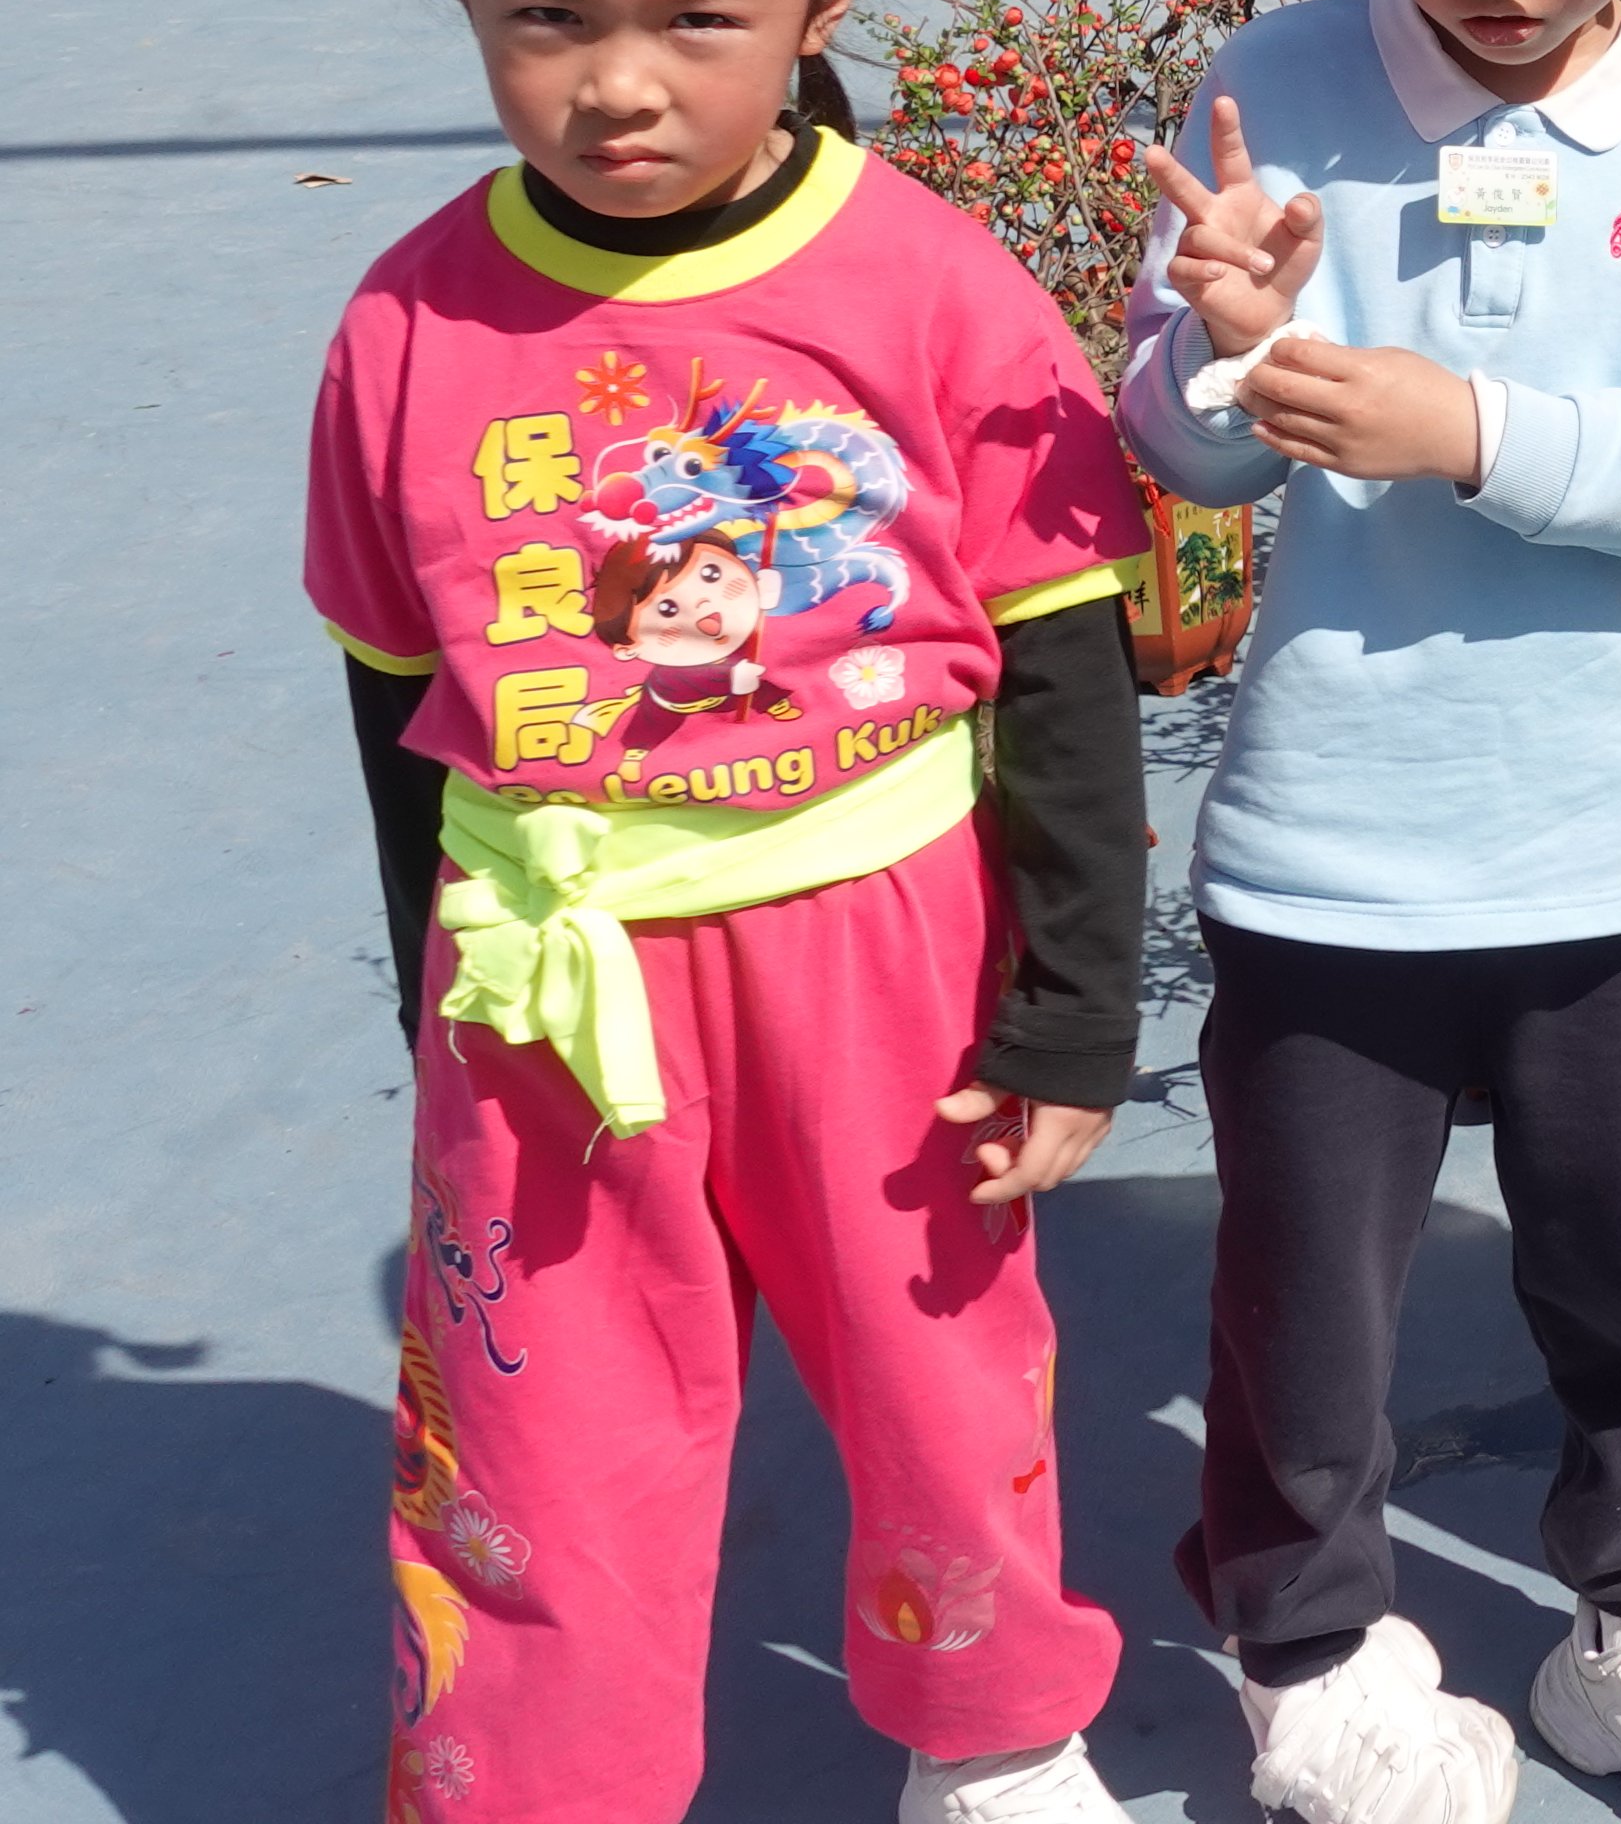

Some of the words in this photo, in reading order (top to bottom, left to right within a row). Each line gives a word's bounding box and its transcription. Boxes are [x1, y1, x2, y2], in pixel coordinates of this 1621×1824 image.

[472, 412, 596, 772] 保良局
[834, 704, 944, 772] Kuk
